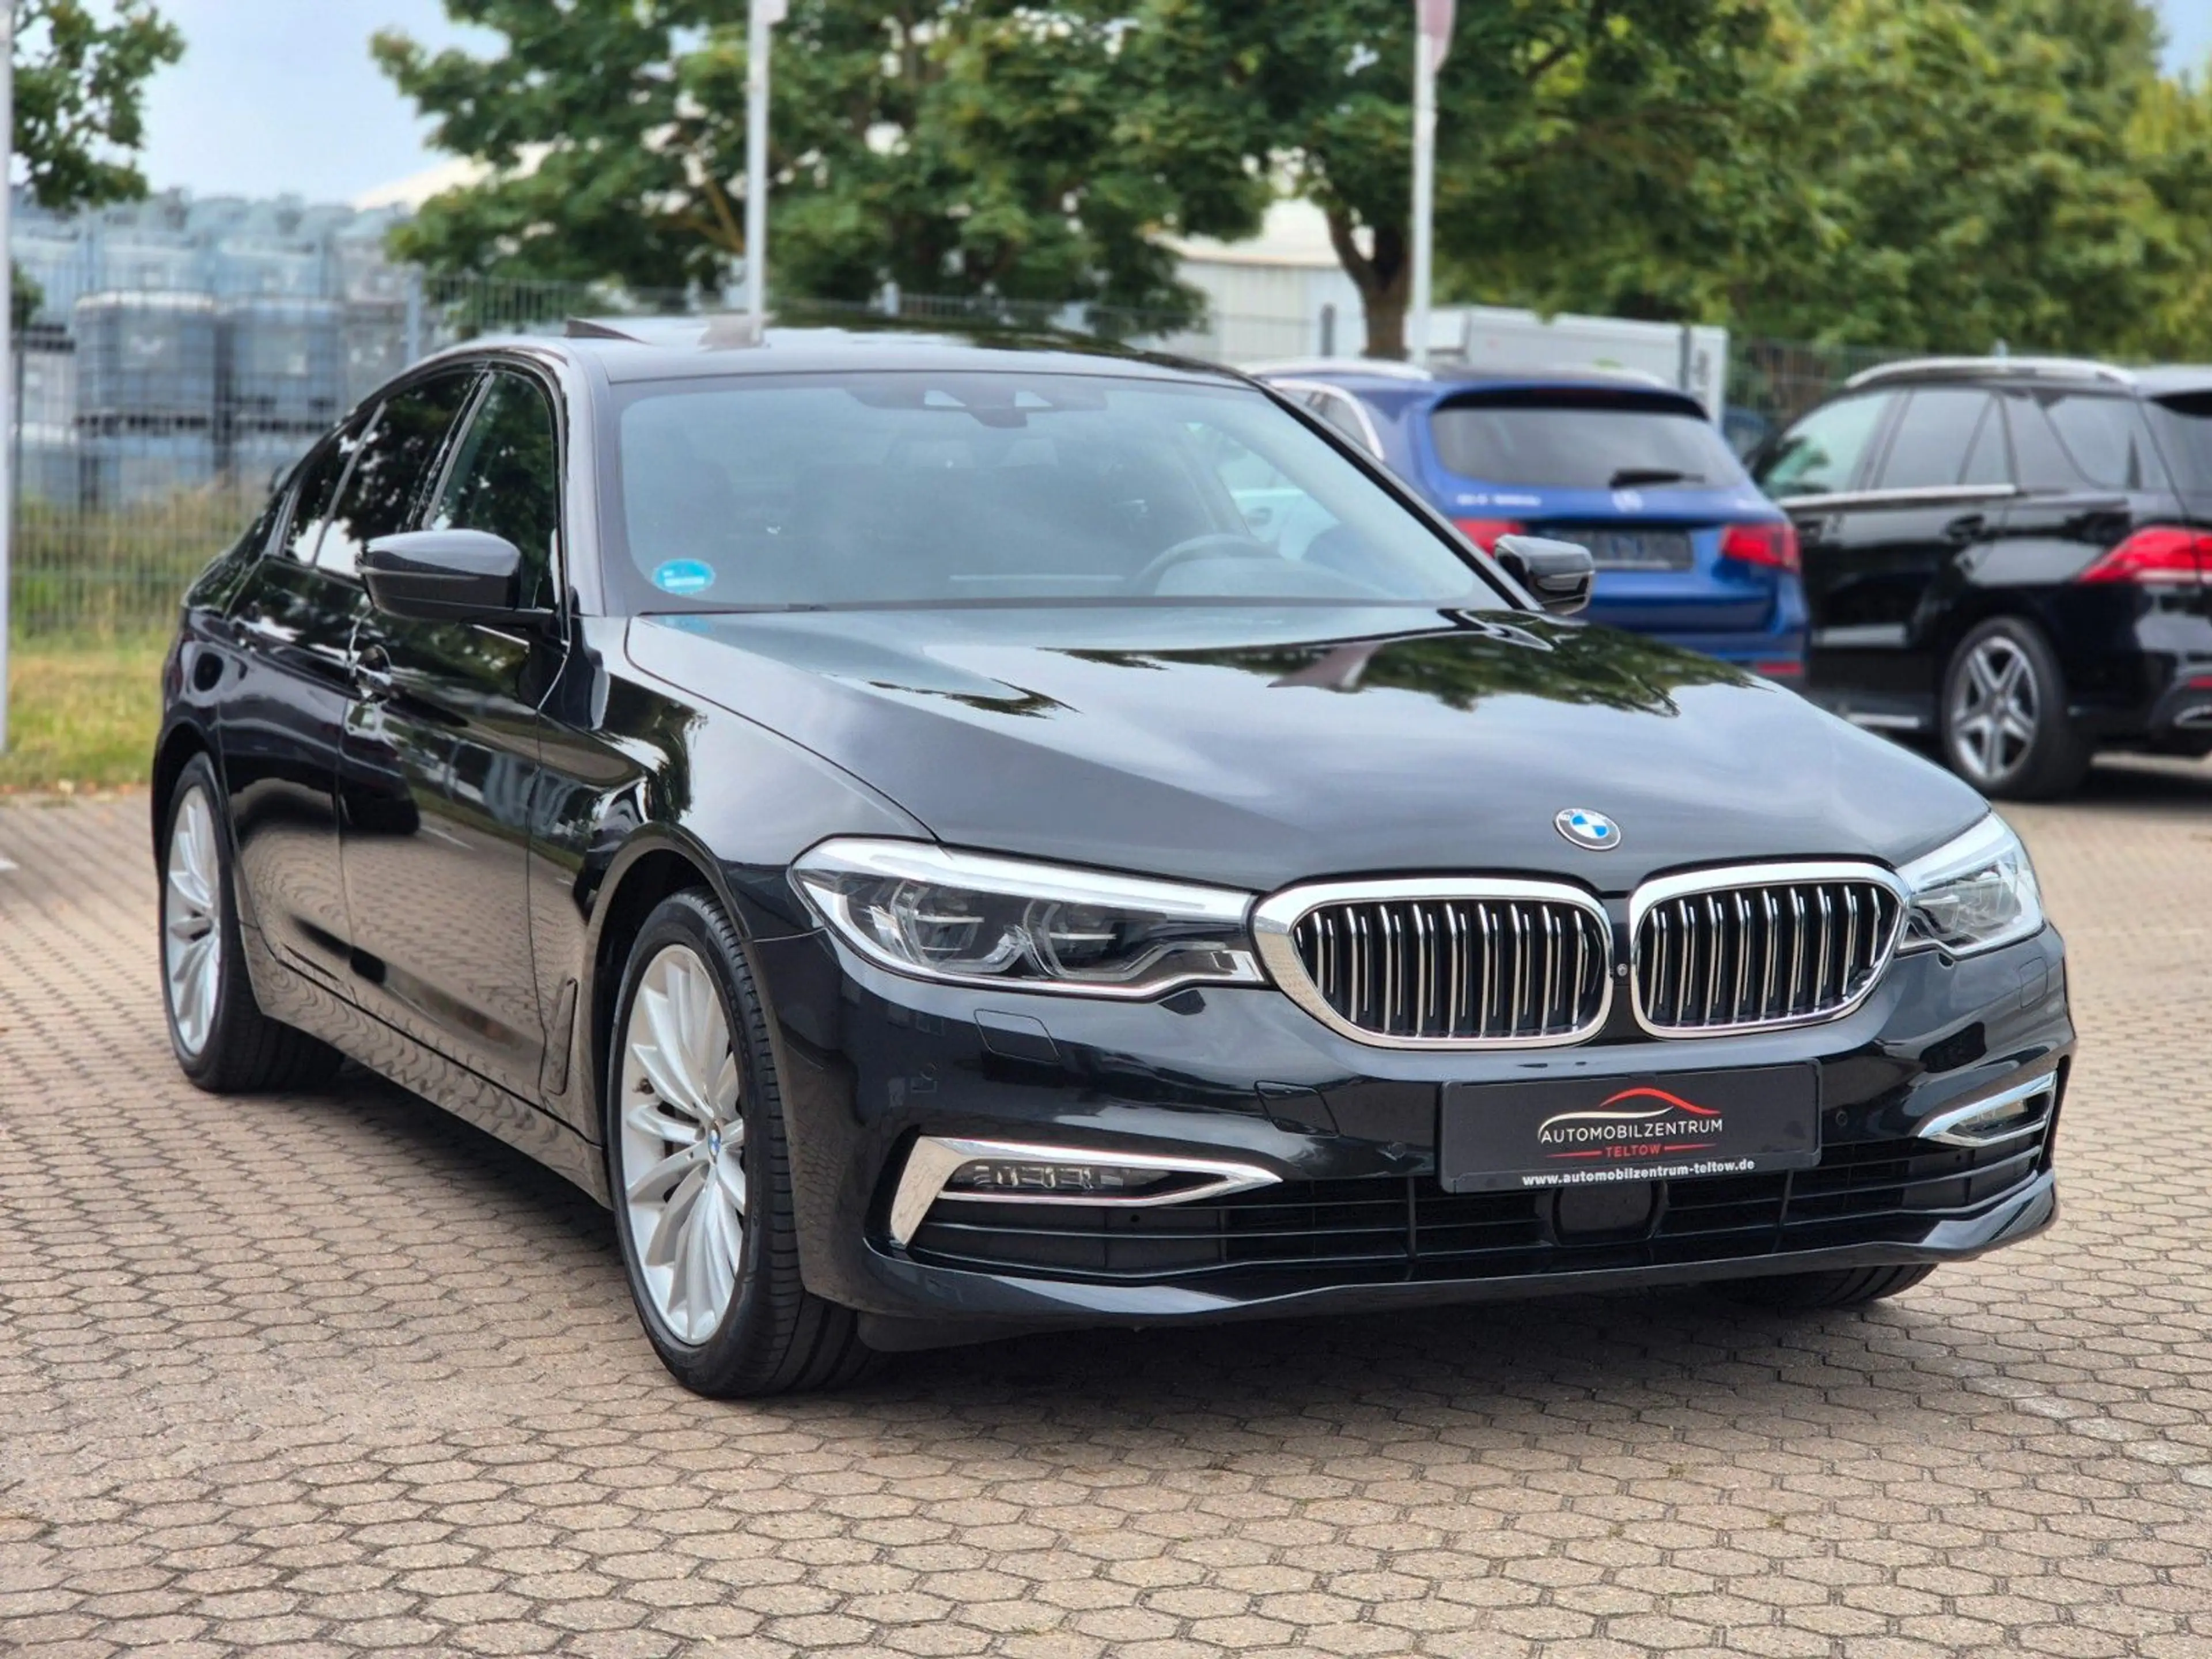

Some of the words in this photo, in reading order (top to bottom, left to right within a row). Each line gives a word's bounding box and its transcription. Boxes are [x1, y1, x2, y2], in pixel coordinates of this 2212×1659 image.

[1540, 1119, 1723, 1144] AUTOMOBILZENTRUM
[1605, 1143, 1661, 1157] TELTOW
[1522, 1158, 1755, 1186] www.automobilzentrum-teltow.de
